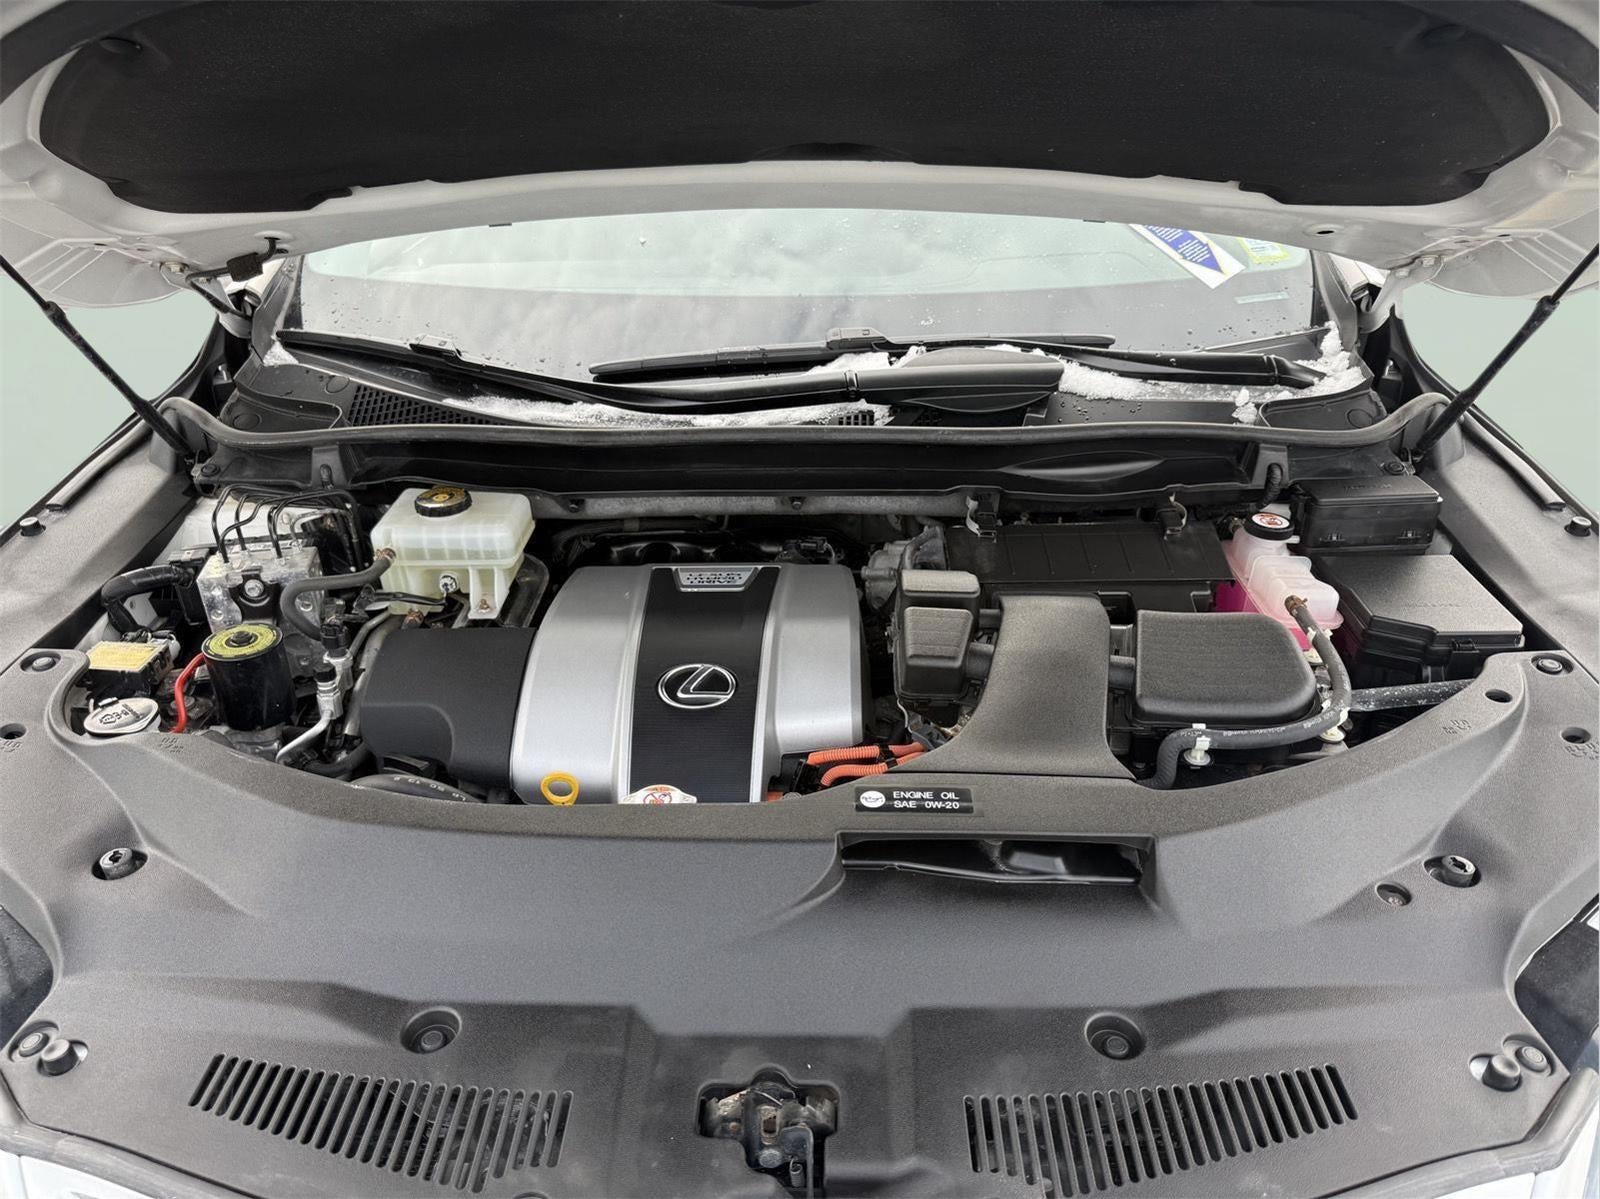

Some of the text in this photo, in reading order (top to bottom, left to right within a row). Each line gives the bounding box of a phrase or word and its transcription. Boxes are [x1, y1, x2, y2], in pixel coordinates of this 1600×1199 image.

[893, 791, 960, 800] ENGINE OIL
[925, 801, 960, 809] 0W-20
